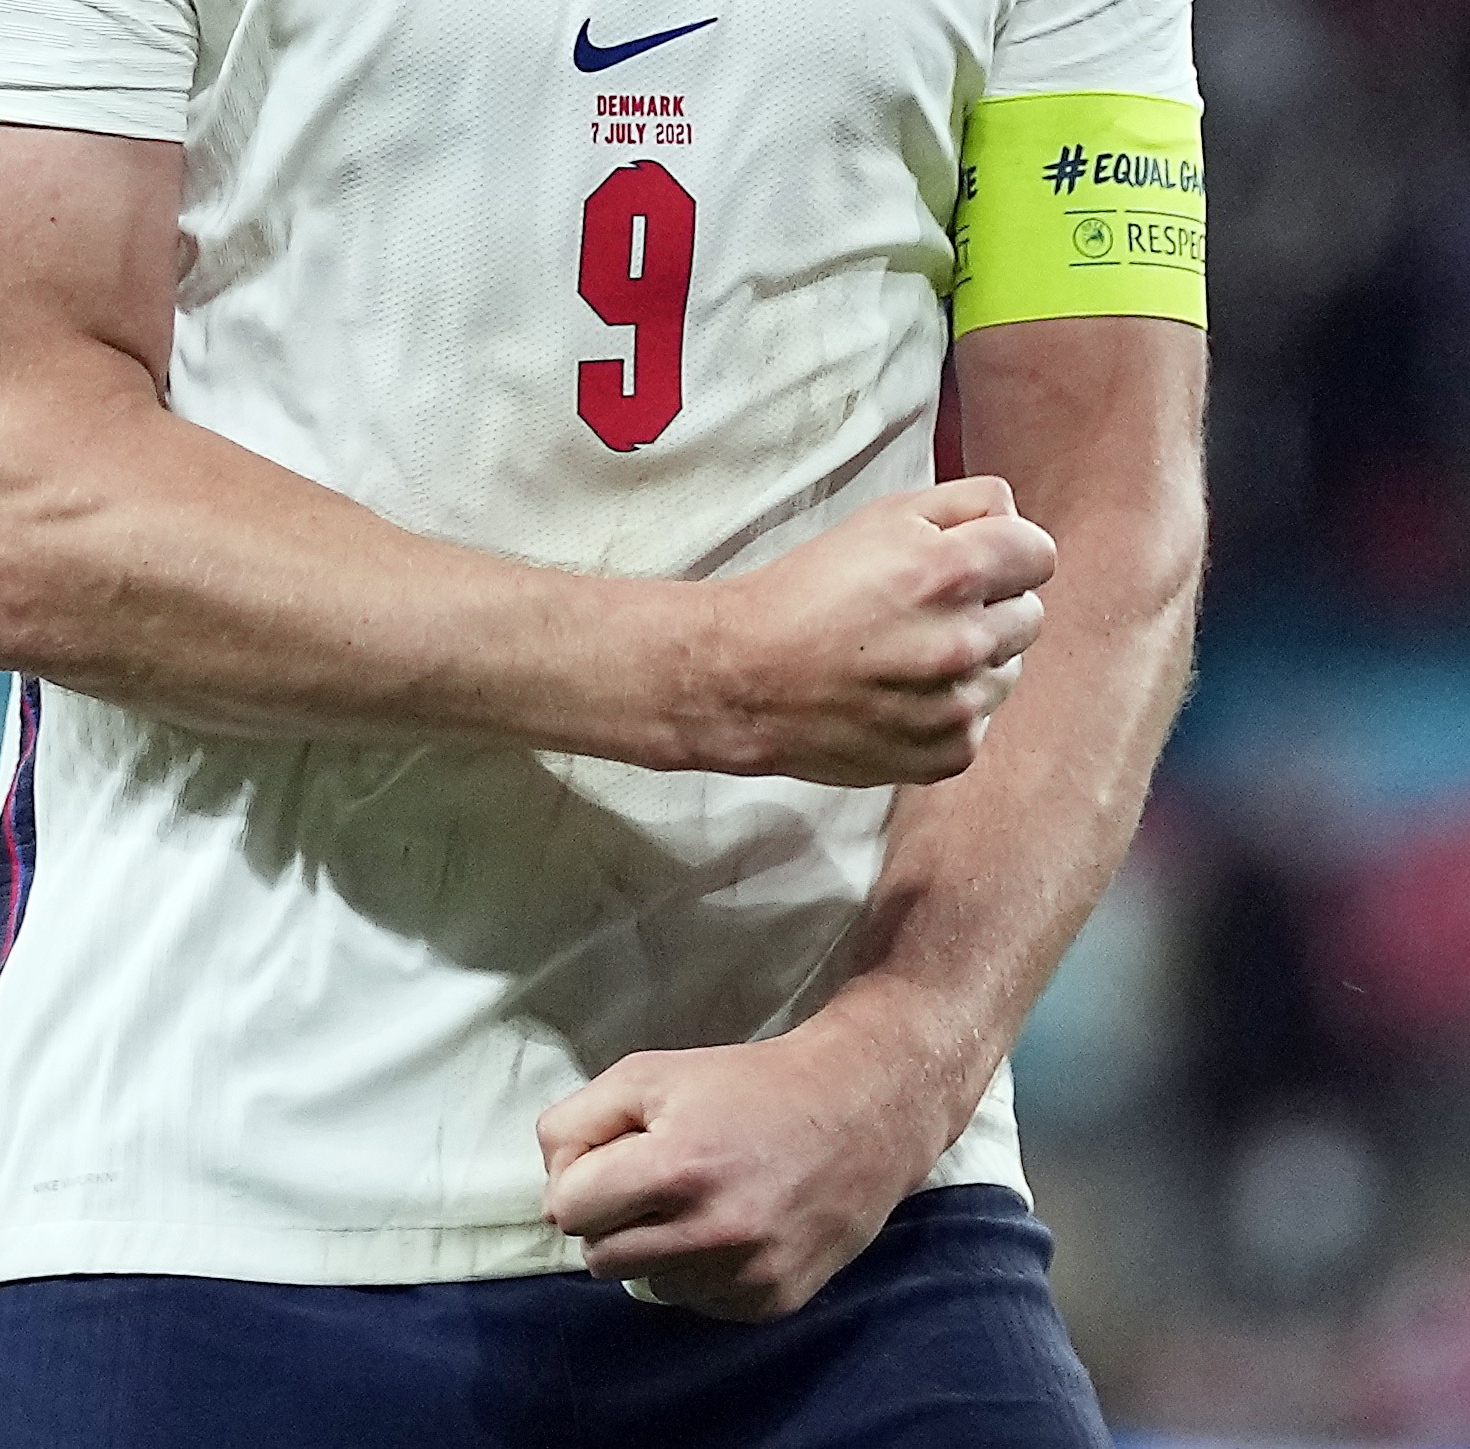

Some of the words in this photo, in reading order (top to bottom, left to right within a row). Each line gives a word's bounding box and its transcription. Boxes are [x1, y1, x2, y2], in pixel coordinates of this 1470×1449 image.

[597, 95, 684, 116] DENMARK
[592, 123, 599, 143] 7
[605, 123, 646, 143] JULY
[656, 123, 692, 144] 2021
[577, 159, 697, 453] 9
